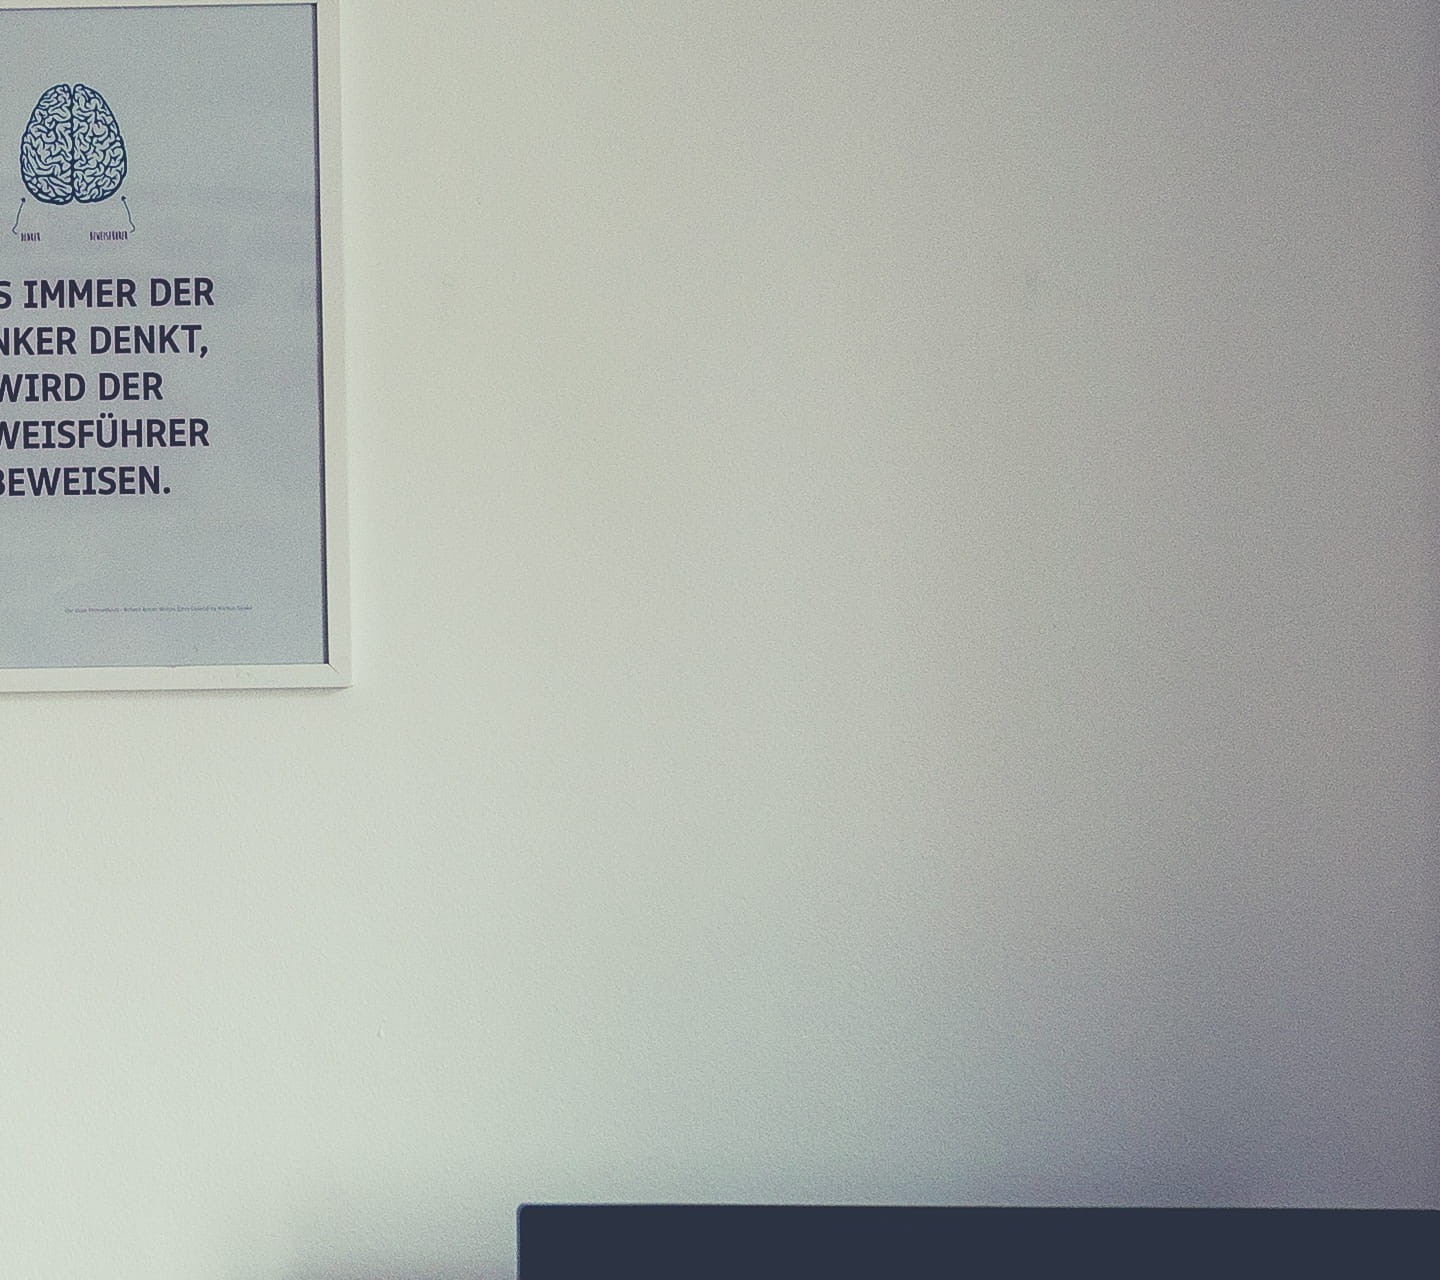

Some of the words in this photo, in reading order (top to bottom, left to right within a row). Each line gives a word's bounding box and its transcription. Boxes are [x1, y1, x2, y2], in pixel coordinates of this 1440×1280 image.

[23, 278, 138, 309] IMMER
[150, 276, 215, 307] DER
[89, 323, 209, 360] DENKT,
[98, 371, 164, 402] DER
